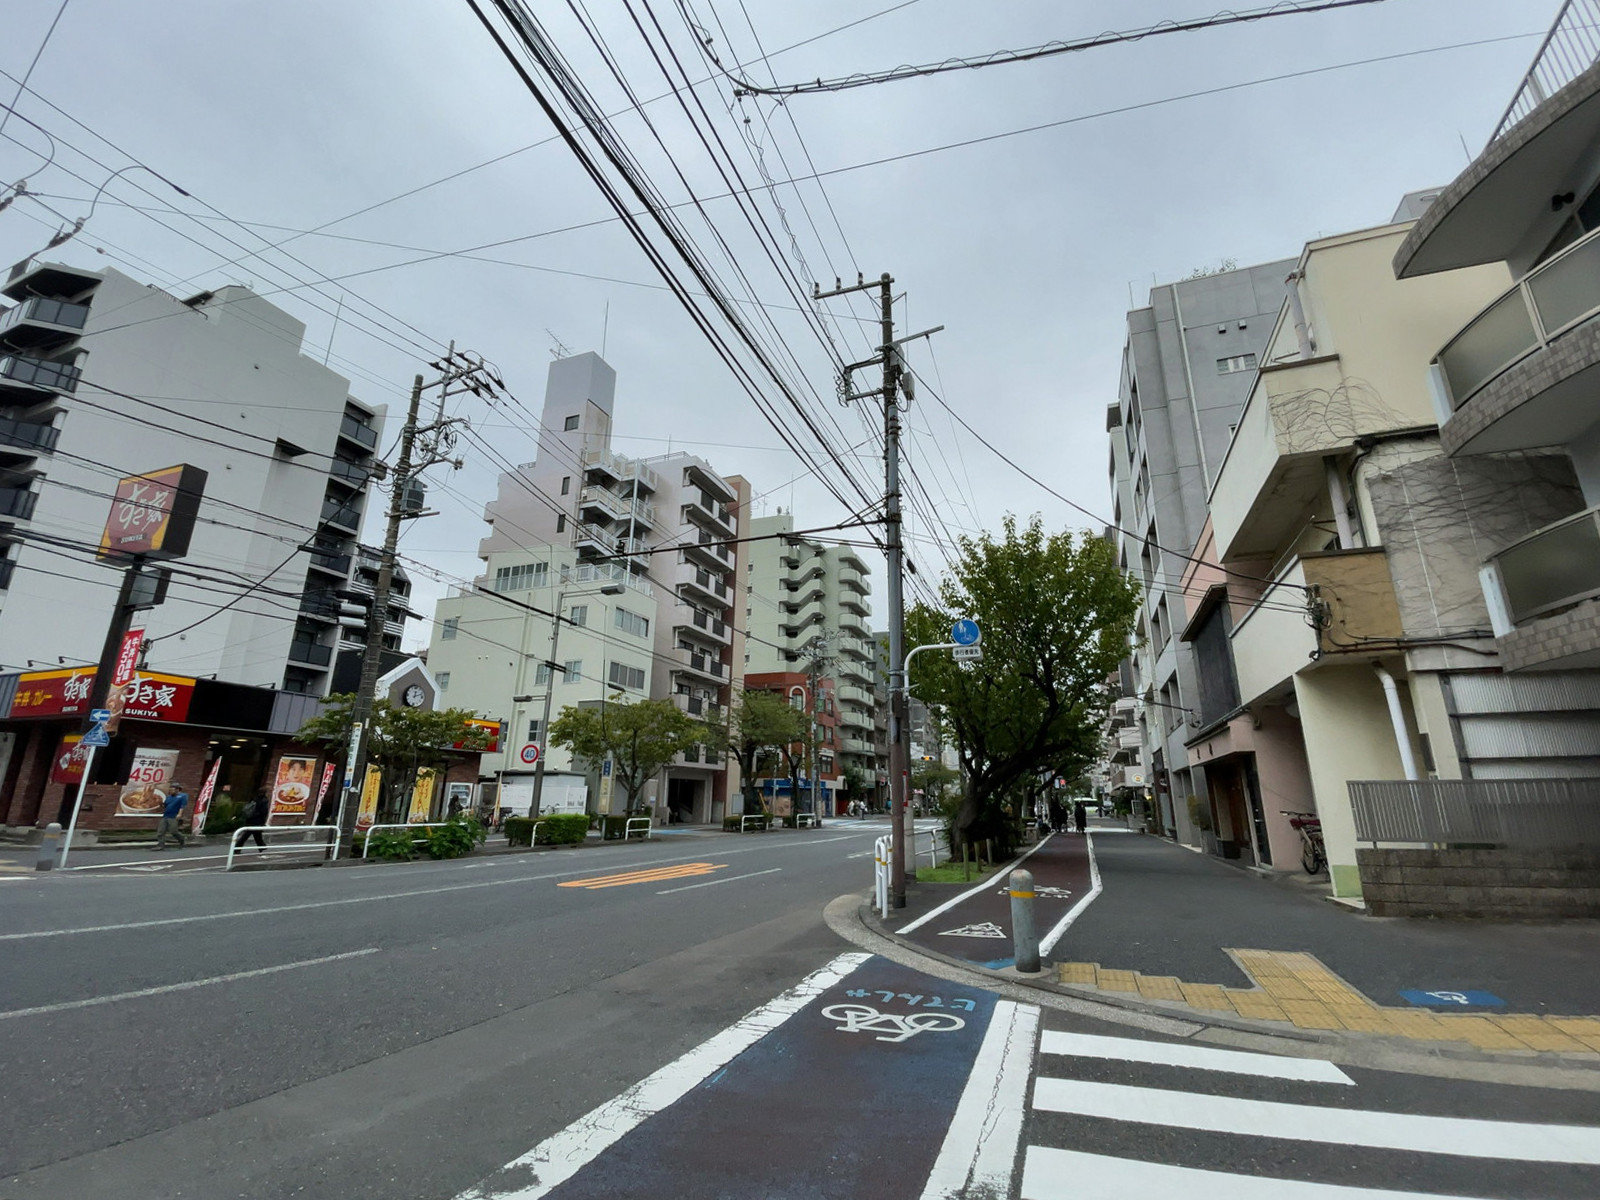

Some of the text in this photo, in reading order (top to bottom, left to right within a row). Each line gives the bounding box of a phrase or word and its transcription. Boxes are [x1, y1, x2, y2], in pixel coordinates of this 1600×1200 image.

[125, 672, 177, 710] すき家
[125, 708, 158, 717] SUKIYA
[525, 749, 536, 759] 40
[129, 767, 164, 783] 450
[846, 988, 977, 1012] じてんしゃ
